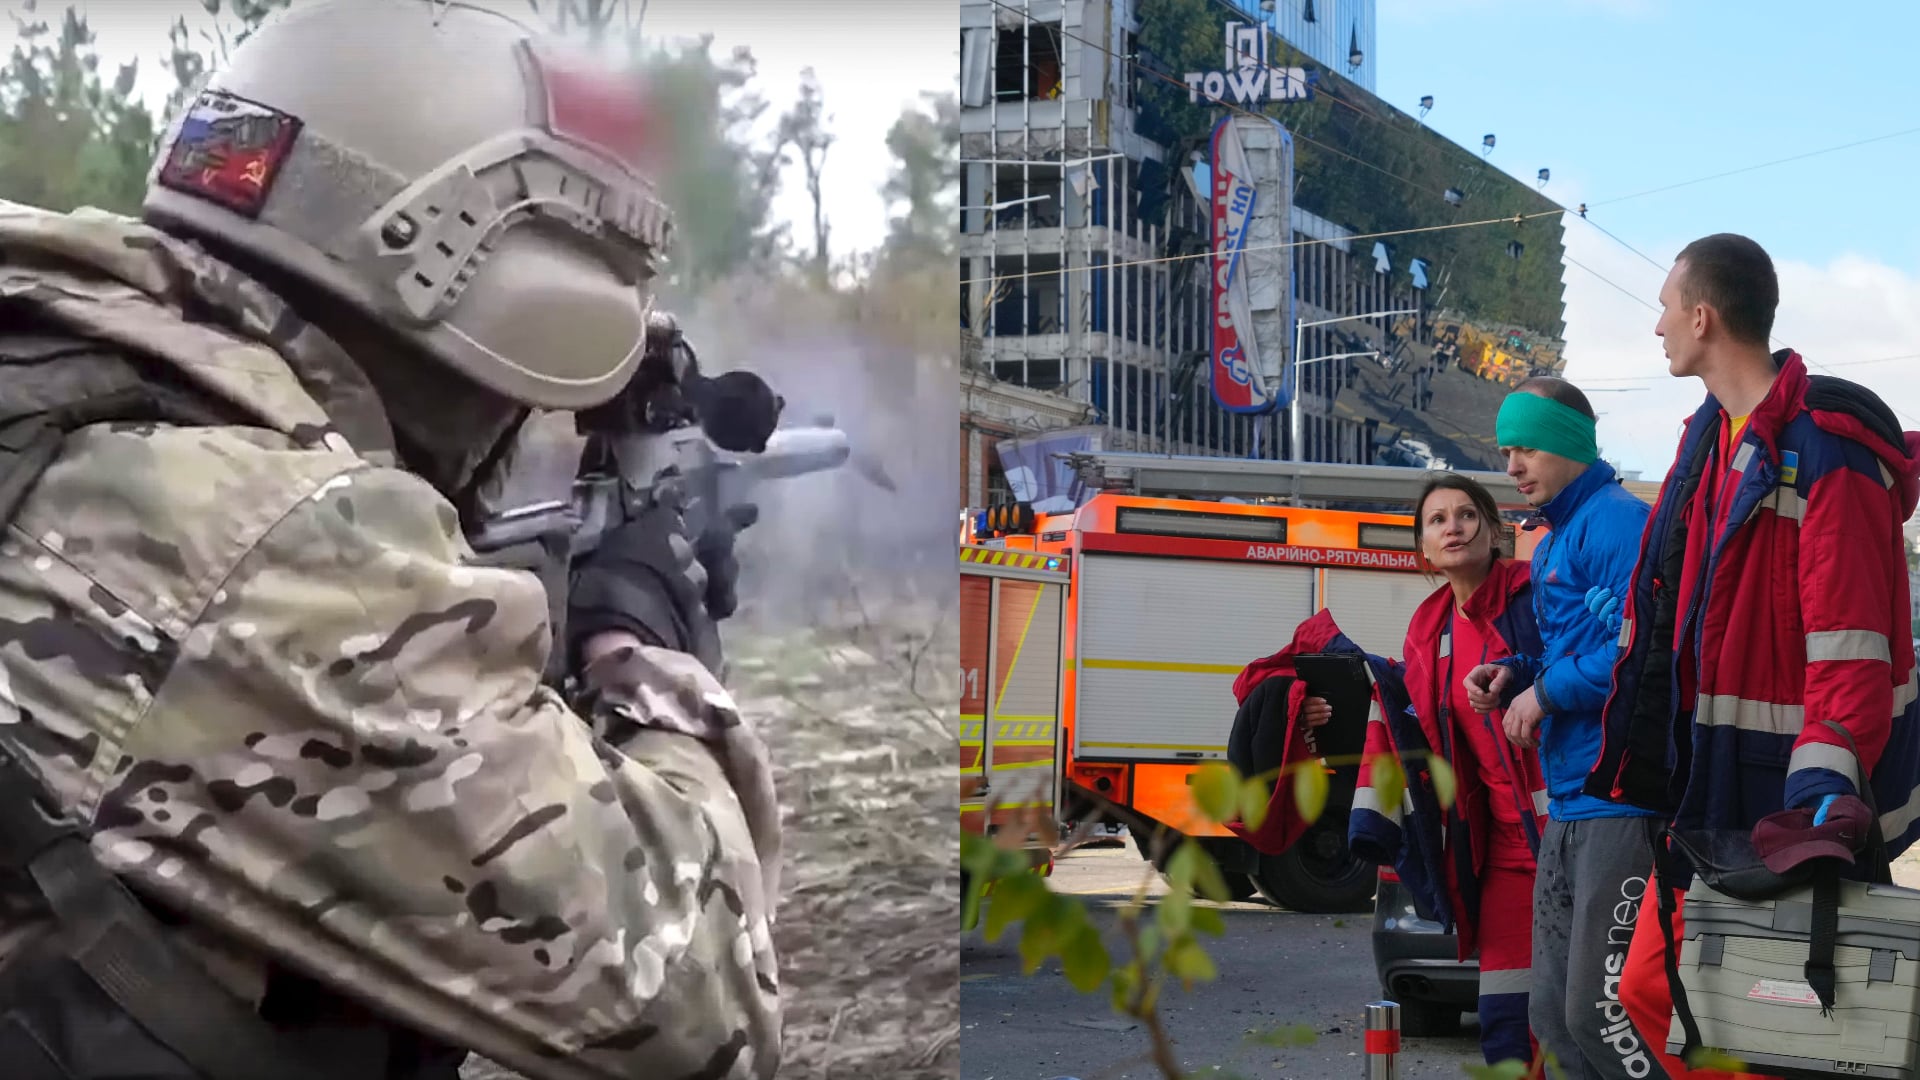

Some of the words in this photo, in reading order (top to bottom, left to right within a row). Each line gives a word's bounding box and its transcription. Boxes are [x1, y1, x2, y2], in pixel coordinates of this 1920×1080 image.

[1184, 67, 1307, 104] TOWER
[1246, 546, 1417, 568] АВАРІЙНО-РЯТУВАЛЬНА
[1608, 876, 1648, 944] neo
[1596, 951, 1650, 1079] adidas
